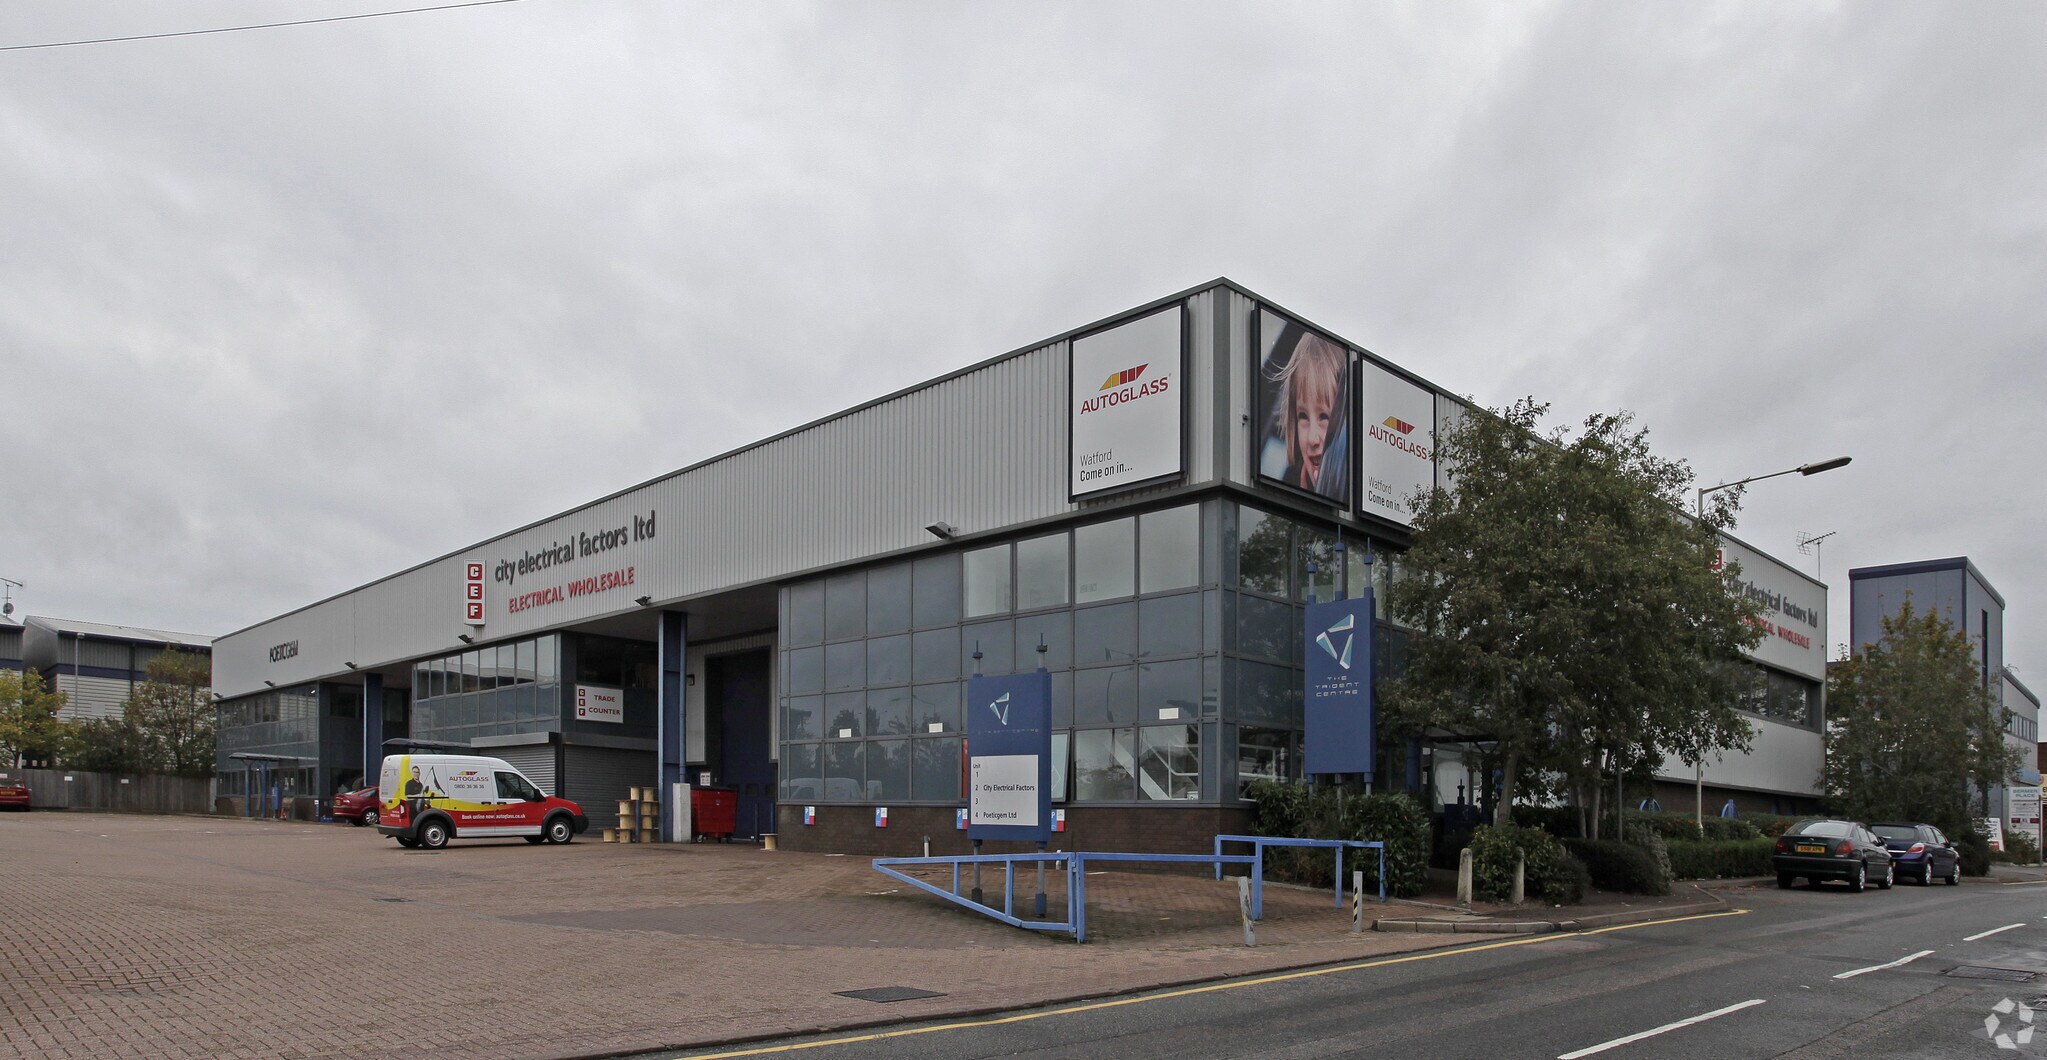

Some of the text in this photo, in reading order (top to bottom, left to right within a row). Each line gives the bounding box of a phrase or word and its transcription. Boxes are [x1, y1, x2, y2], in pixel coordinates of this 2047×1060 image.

[1080, 376, 1169, 415] AUTOGLASS
[1368, 424, 1428, 460] AUTOGLASS
[1080, 448, 1112, 467] Watford
[1080, 467, 1103, 482] Come
[1104, 465, 1115, 477] on
[1368, 475, 1392, 495] Watford
[1368, 490, 1385, 507] Come
[1385, 498, 1394, 509] on
[494, 509, 656, 585] city electrical factors ltd
[508, 566, 635, 614] ELECTRICAL WHOLESALE
[1315, 681, 1359, 689] TRIDENT
[1315, 689, 1358, 697] CENTRE
[983, 784, 993, 792] City
[975, 797, 979, 805] 3
[983, 811, 1008, 820] Poeticgem
[1008, 811, 1017, 819] Ltd
